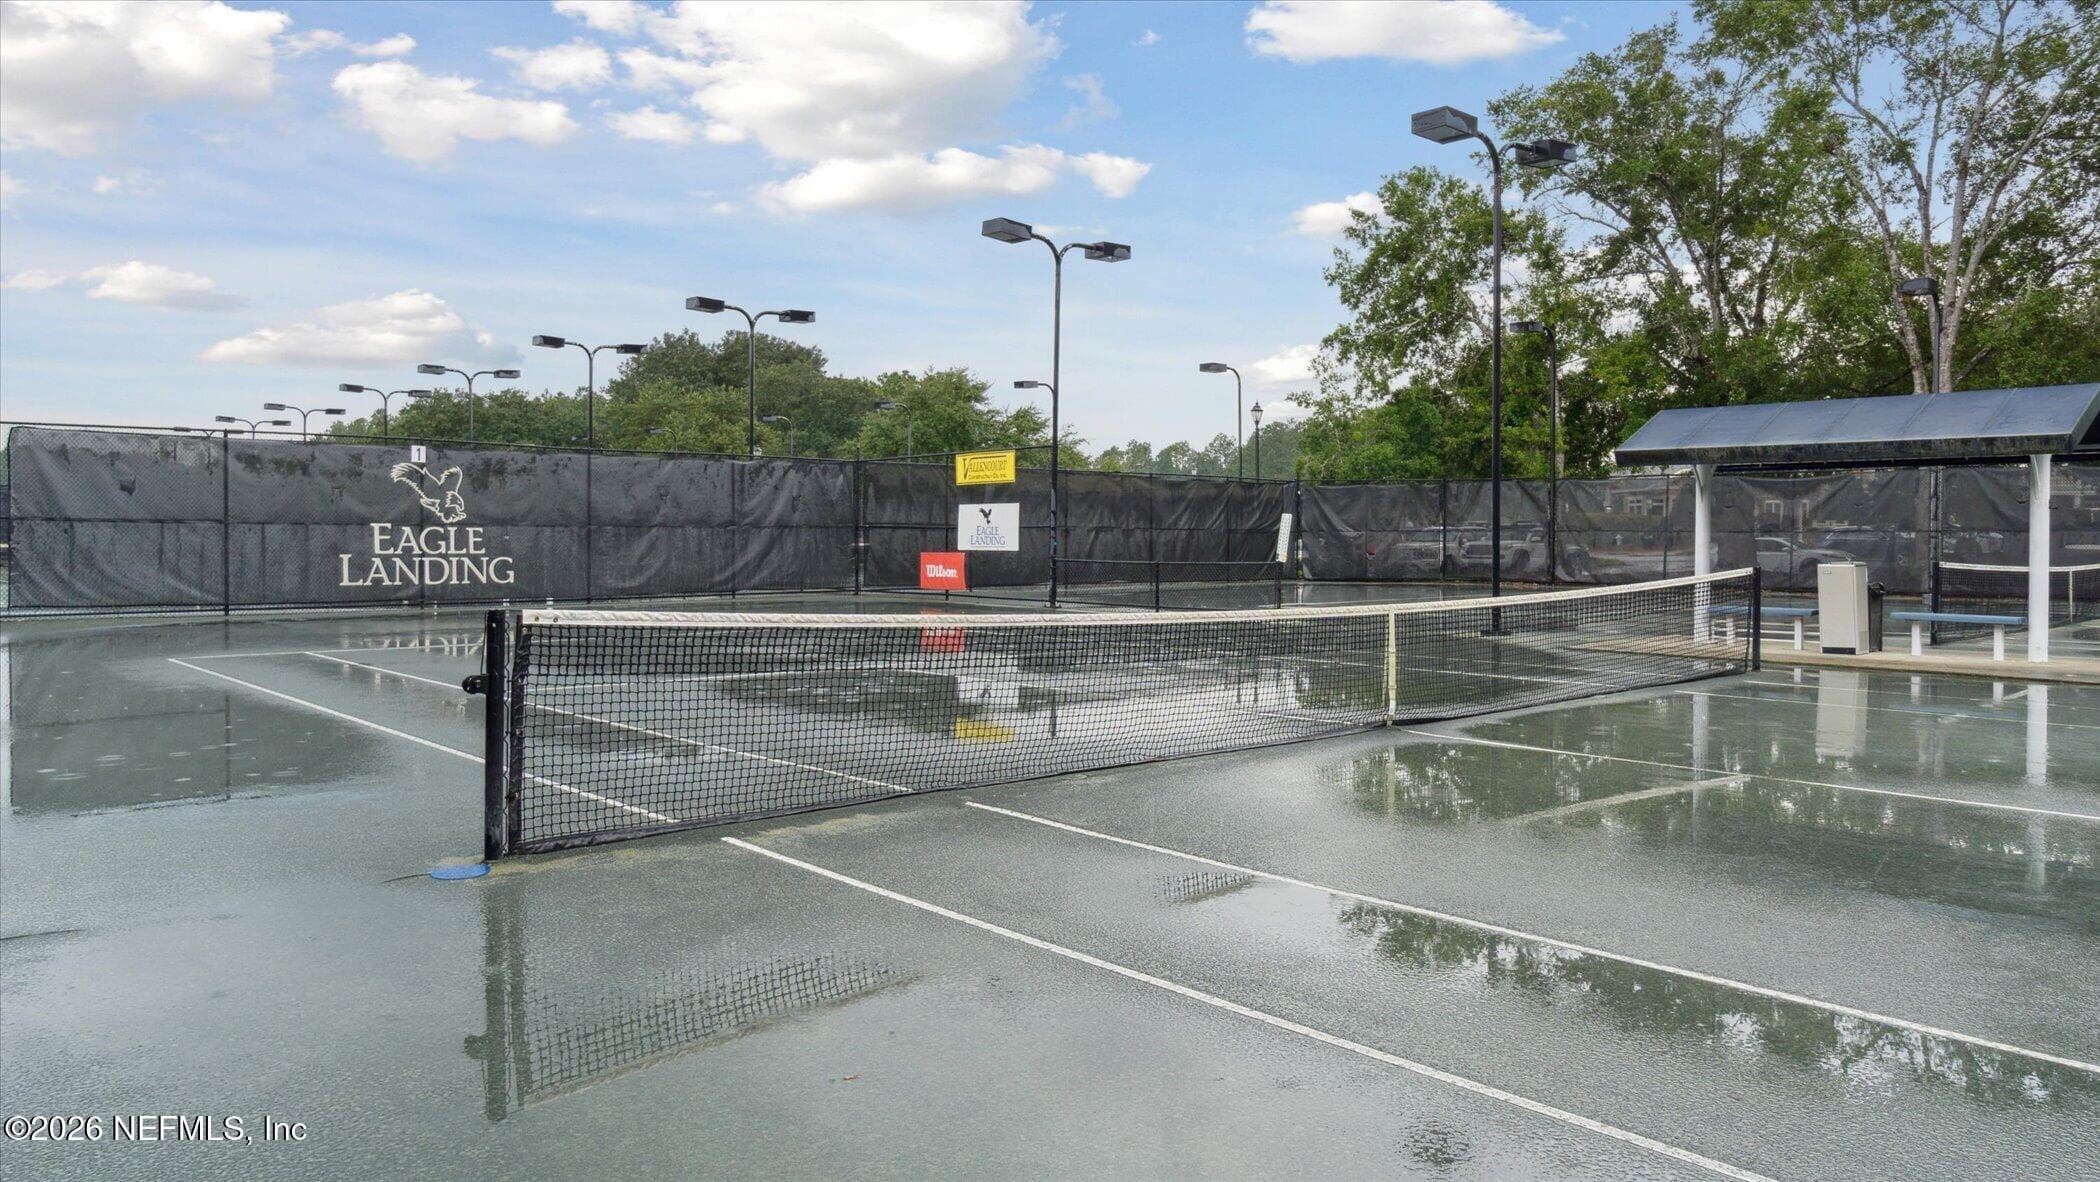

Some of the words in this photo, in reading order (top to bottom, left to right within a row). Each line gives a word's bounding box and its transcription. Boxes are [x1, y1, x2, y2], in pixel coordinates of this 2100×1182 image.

[416, 448, 421, 461] 1
[976, 525, 1000, 536] EAGLE
[370, 523, 486, 554] EAGLE
[970, 534, 1006, 545] LANDING
[339, 554, 515, 586] LANDING
[926, 564, 958, 578] Wilson
